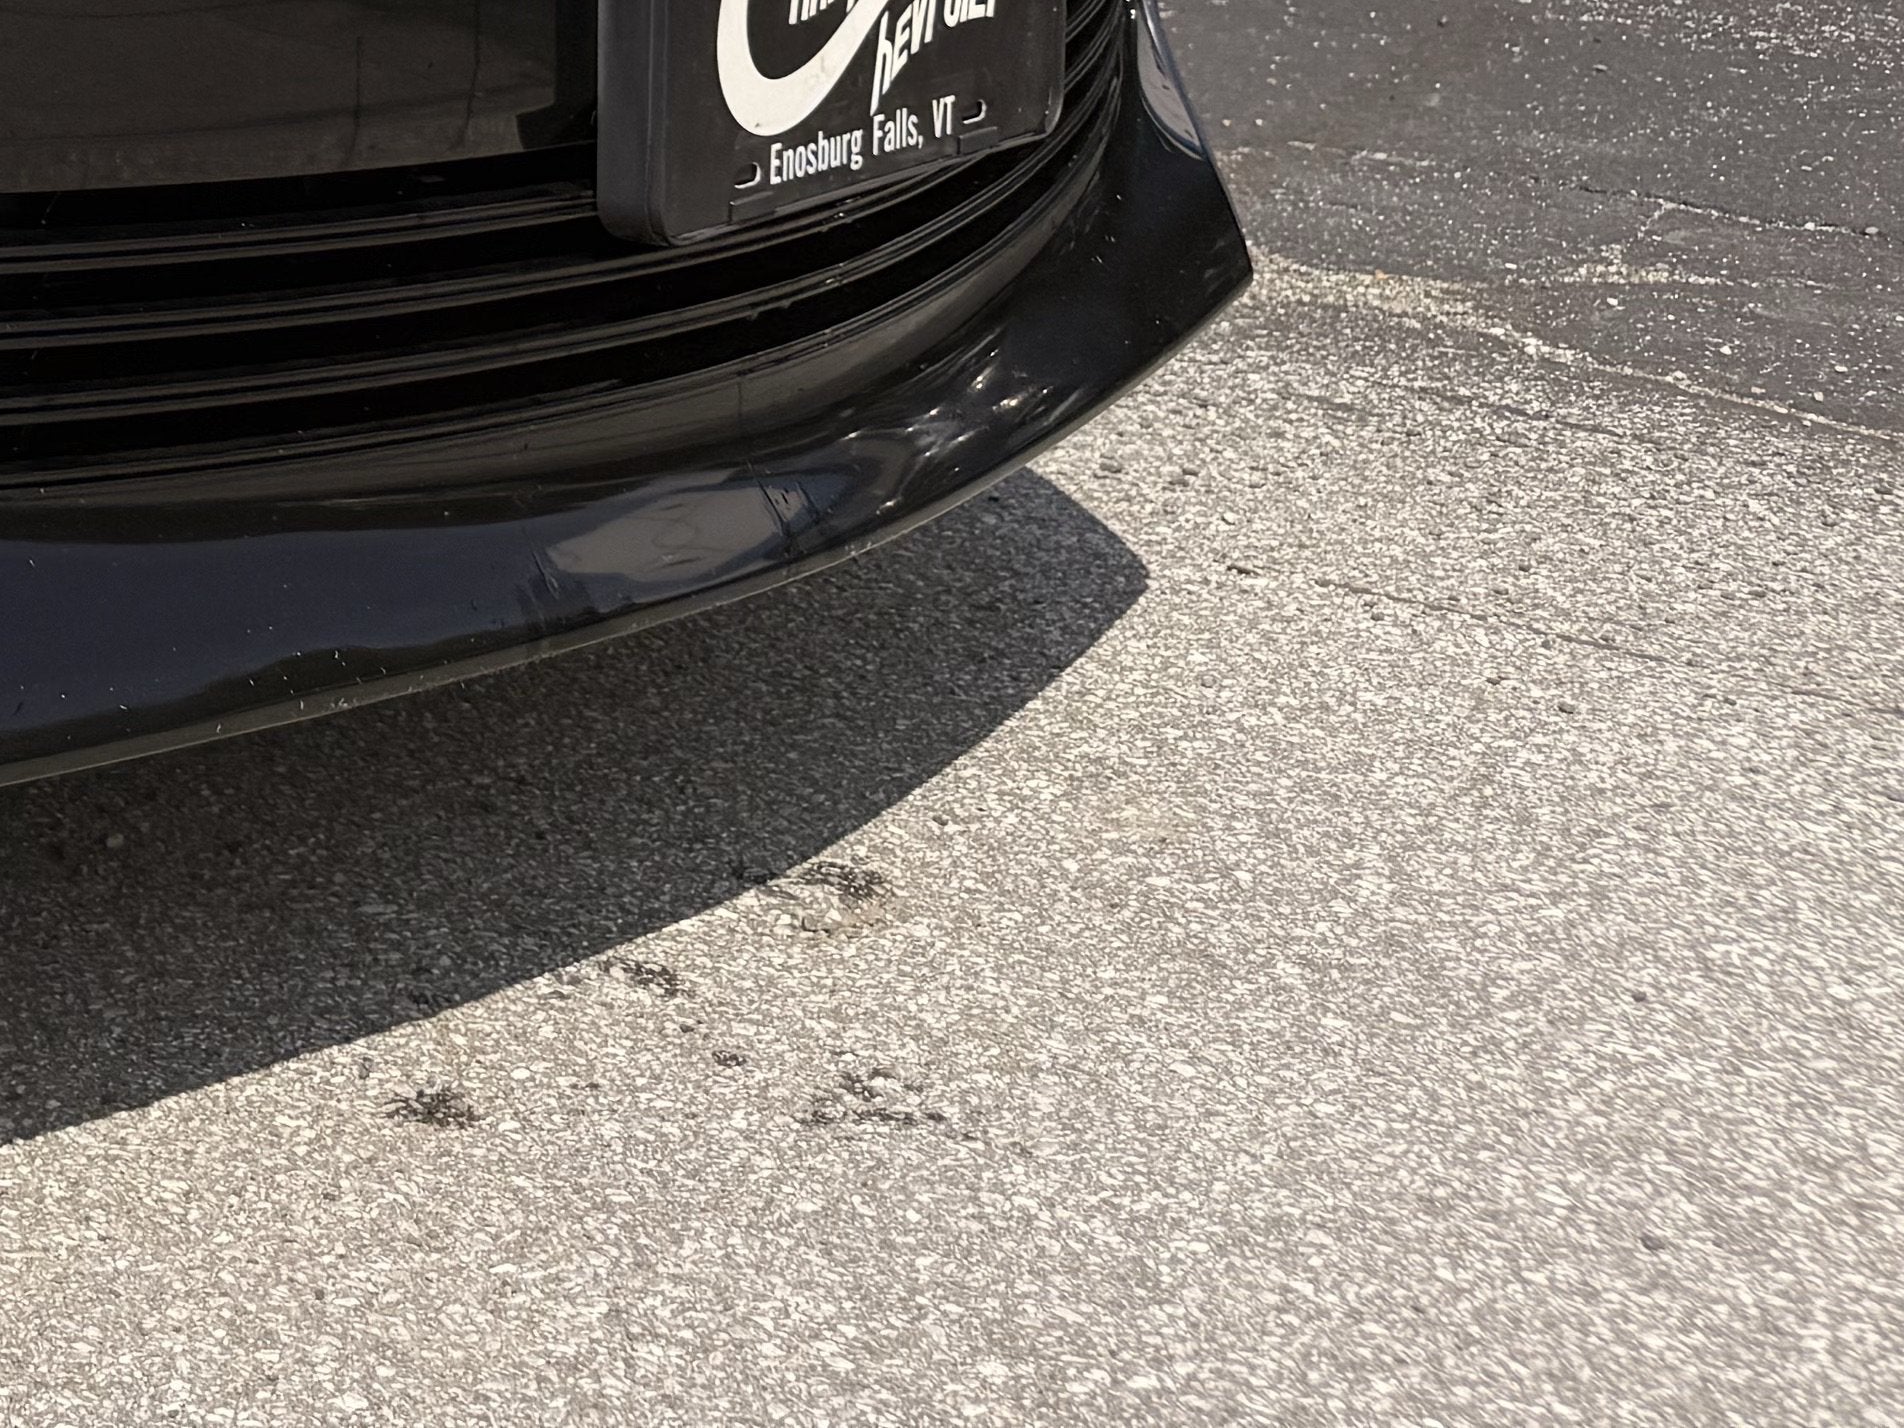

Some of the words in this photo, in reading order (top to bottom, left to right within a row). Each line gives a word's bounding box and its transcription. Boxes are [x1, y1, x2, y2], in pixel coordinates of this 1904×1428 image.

[769, 130, 863, 185] Enosburg
[872, 106, 923, 155] Falls,
[932, 94, 956, 138] VT
